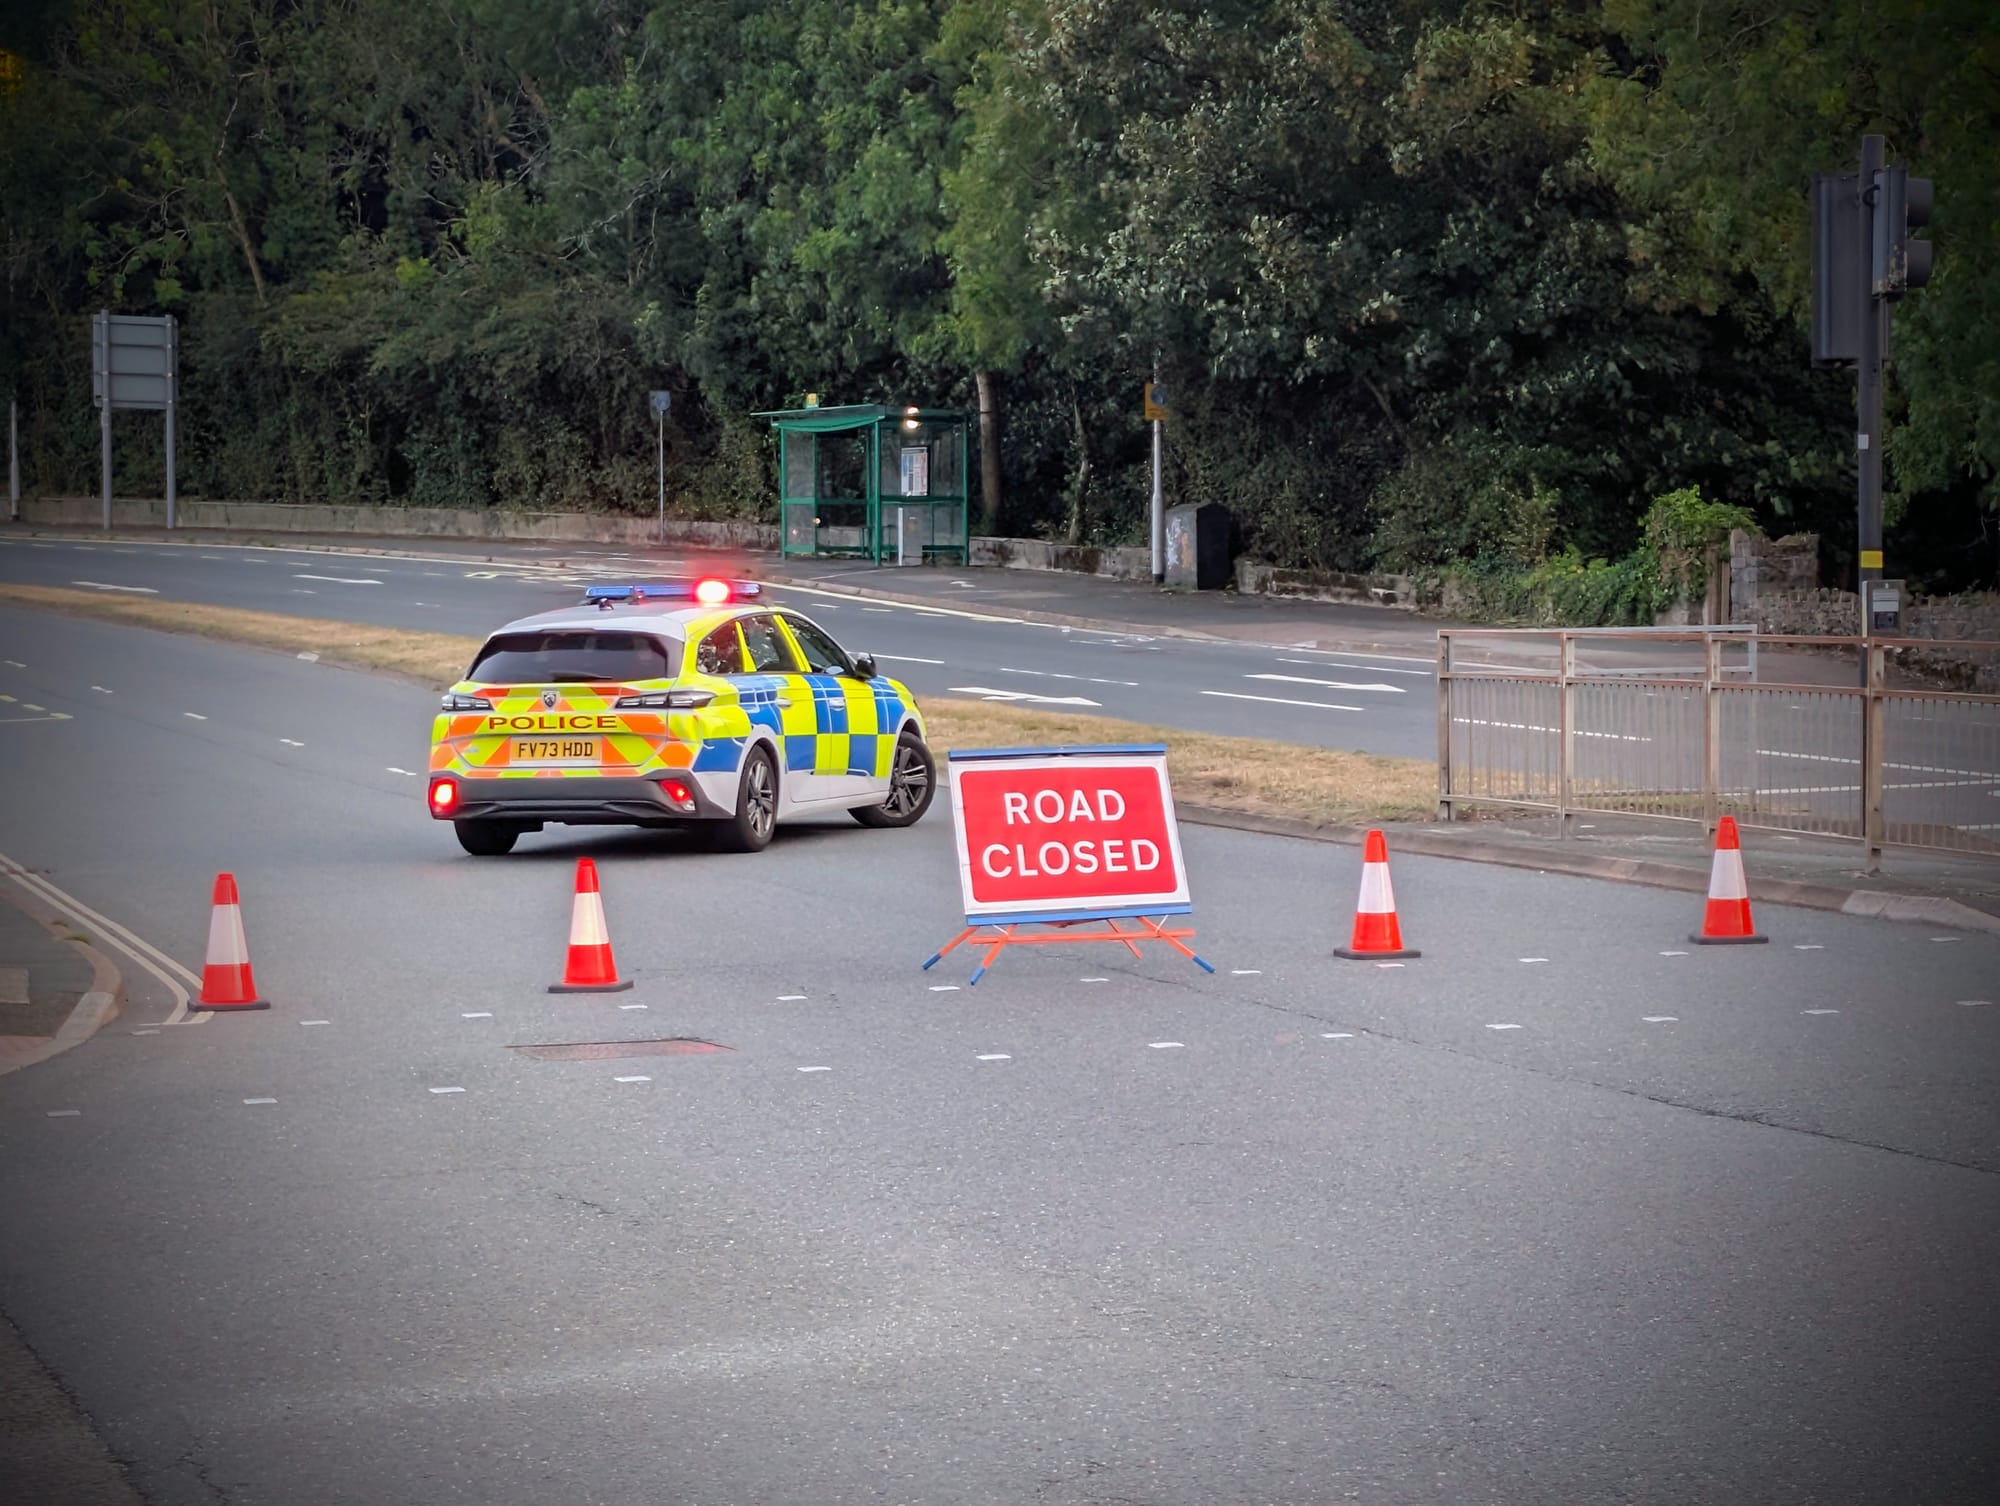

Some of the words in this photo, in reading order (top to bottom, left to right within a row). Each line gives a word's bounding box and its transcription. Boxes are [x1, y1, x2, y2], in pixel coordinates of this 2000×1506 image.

[489, 715, 618, 730] POLICE
[518, 743, 559, 758] FV73
[562, 742, 593, 757] HDD
[1004, 789, 1126, 825] ROAD
[982, 839, 1160, 878] CLOSED
